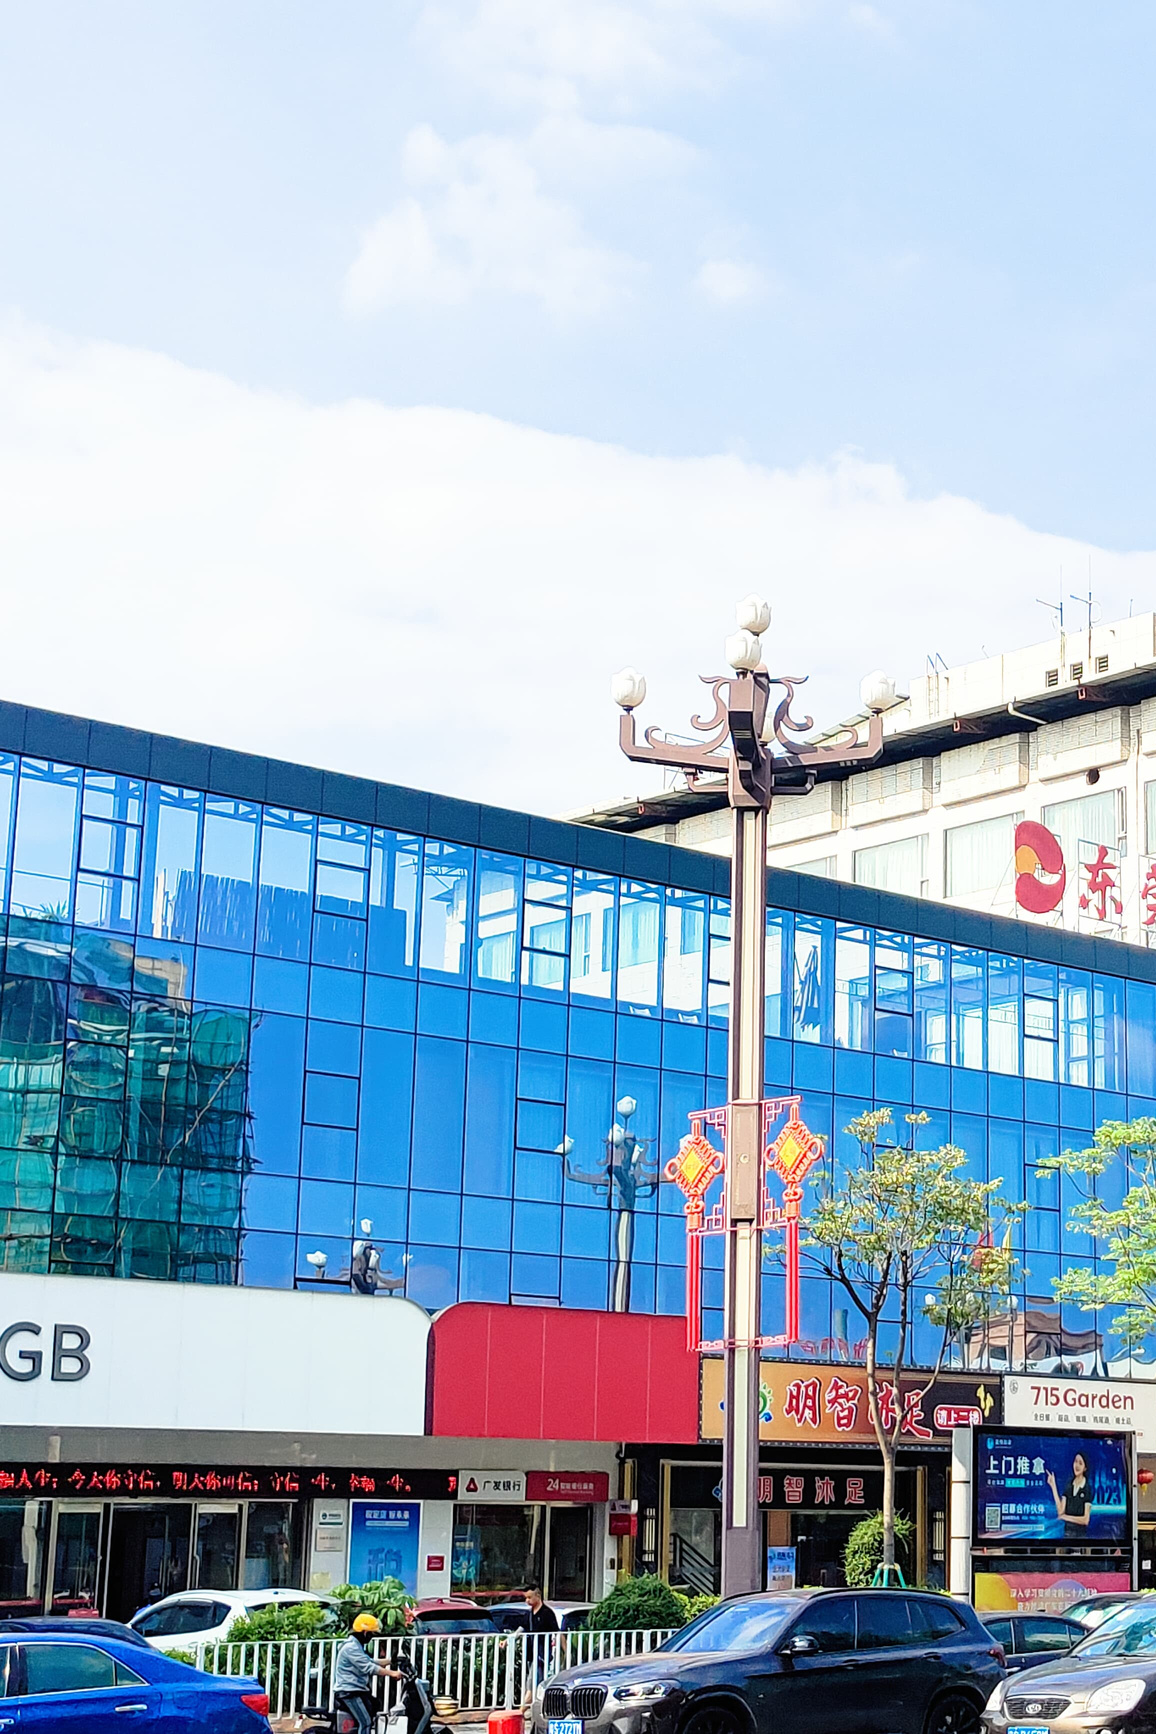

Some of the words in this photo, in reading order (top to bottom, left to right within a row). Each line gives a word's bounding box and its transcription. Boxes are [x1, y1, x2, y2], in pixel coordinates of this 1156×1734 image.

[0, 1321, 91, 1381] GB
[1030, 1386, 1060, 1406] 715
[1063, 1388, 1135, 1411] Garden
[483, 1479, 522, 1491] 广发银行
